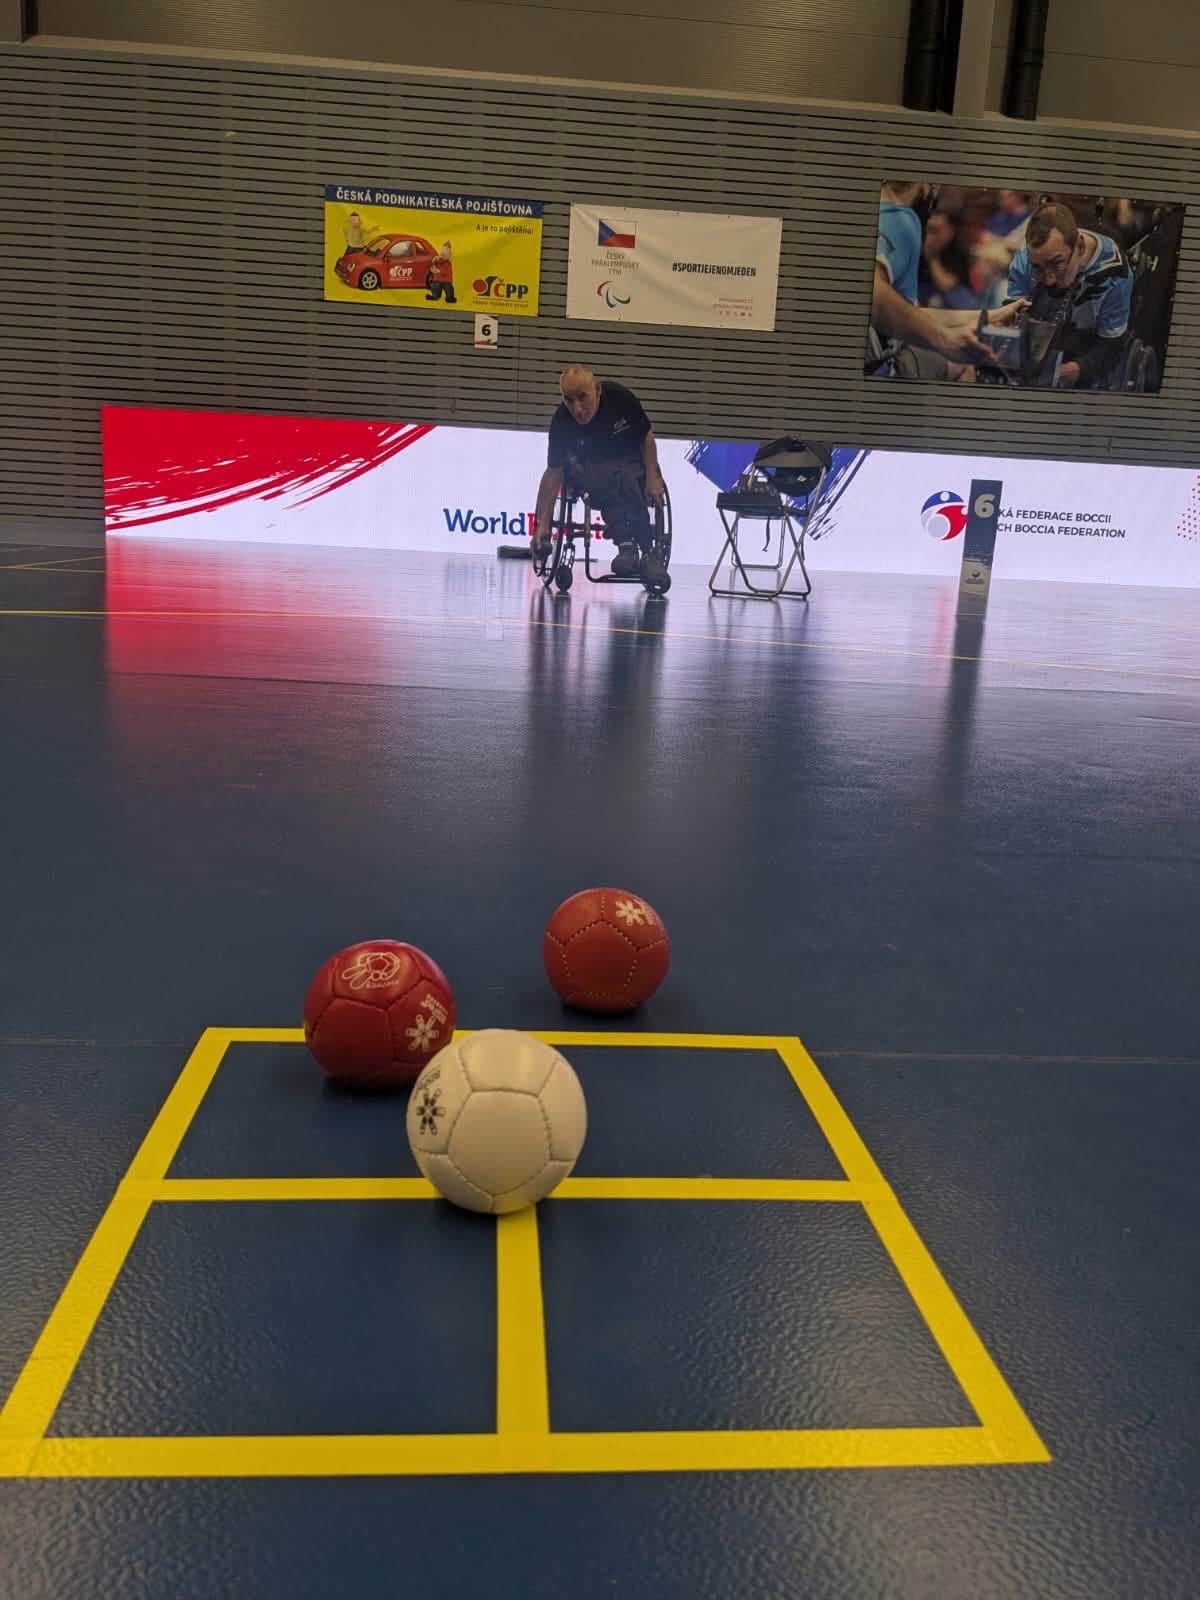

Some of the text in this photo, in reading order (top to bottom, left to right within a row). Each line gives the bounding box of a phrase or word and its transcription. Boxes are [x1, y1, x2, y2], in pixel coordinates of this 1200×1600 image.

[336, 187, 533, 216] ČESKÁ PODNIKATELSKÁ POJIŠŤOVNA
[491, 224, 498, 232] to
[493, 278, 529, 299] ČPP
[481, 324, 492, 337] 6
[973, 493, 996, 518] 6
[1016, 509, 1073, 521] FEDERACE
[1075, 512, 1112, 523] BOCCII
[1014, 523, 1055, 535] BOCCIA
[1057, 525, 1126, 539] FEDERATION
